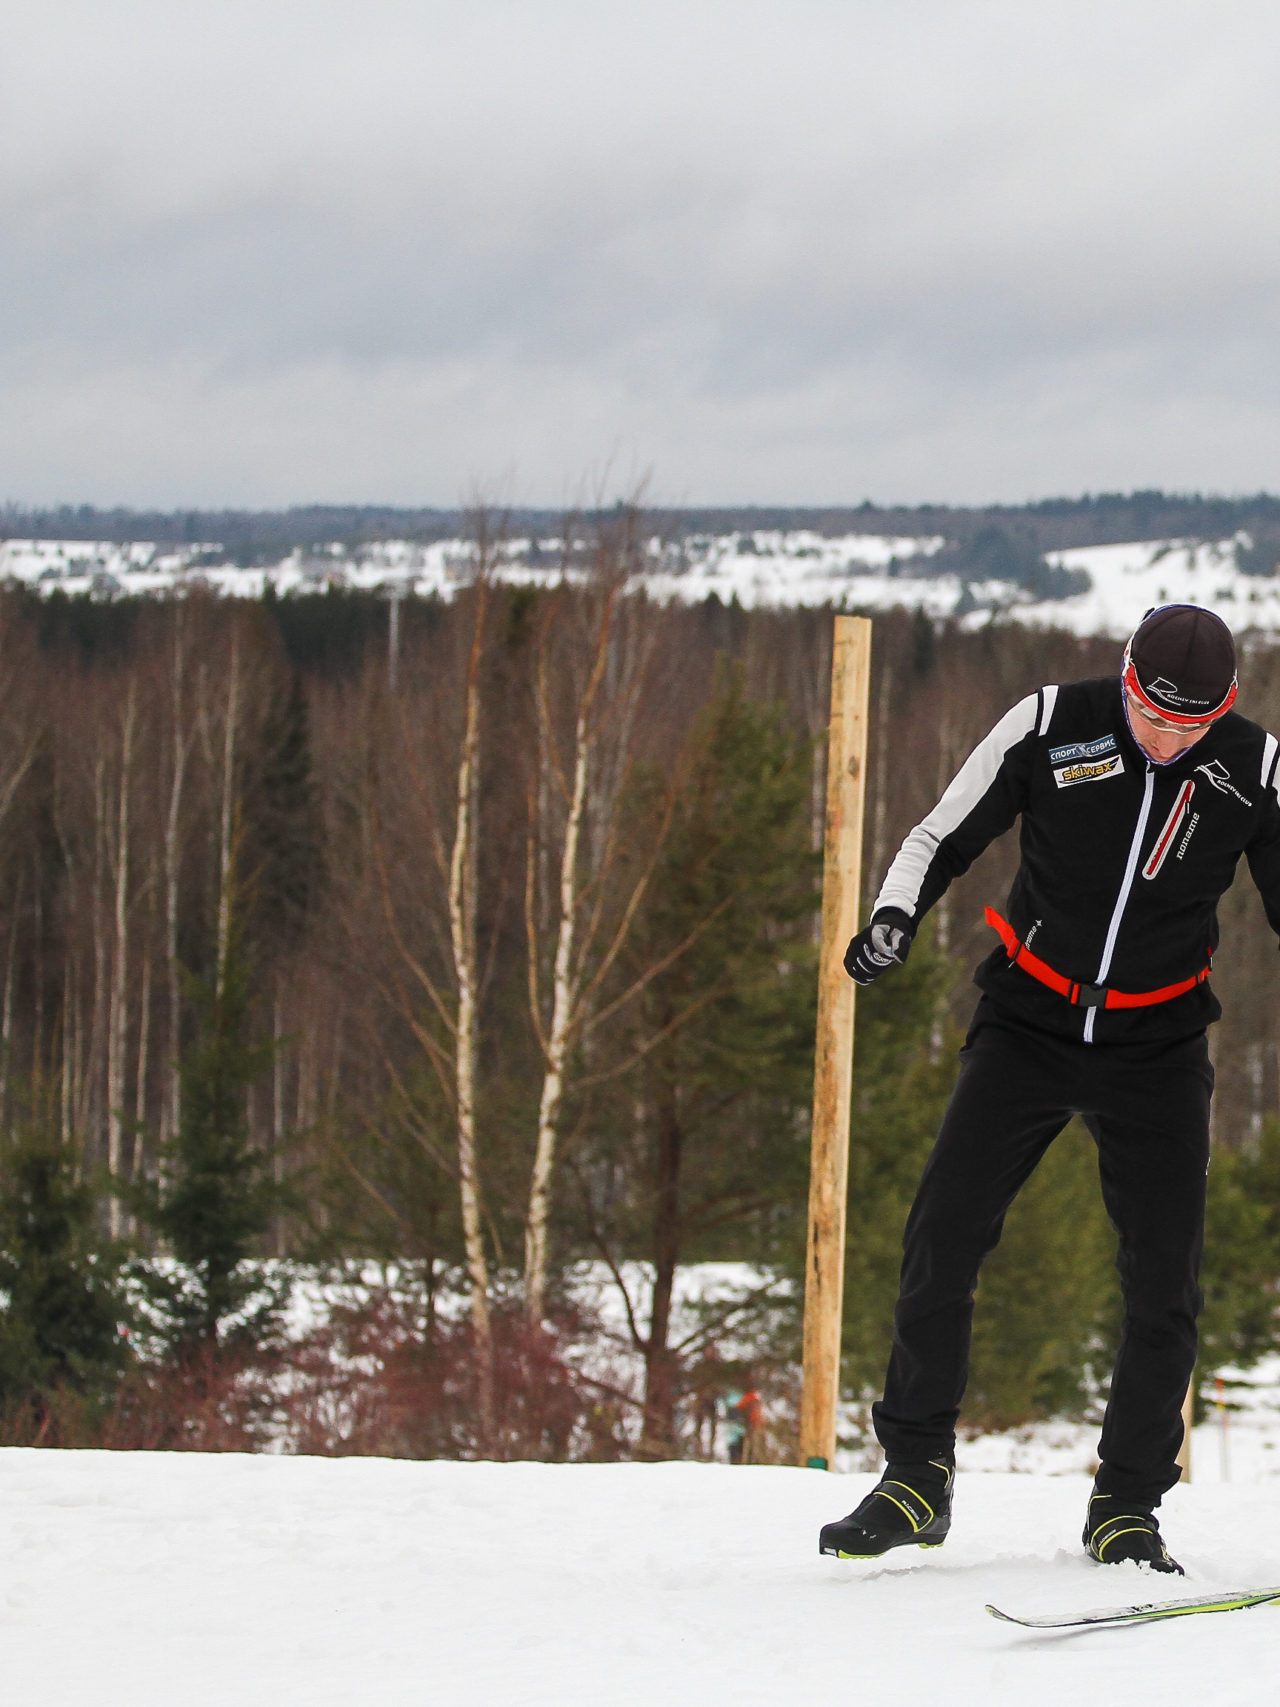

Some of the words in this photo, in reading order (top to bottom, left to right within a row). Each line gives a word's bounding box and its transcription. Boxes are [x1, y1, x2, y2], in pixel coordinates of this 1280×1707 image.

[1050, 747, 1077, 761] СПОРТ
[1086, 738, 1116, 755] СЕРВИС
[1063, 762, 1112, 781] skiwax
[1176, 812, 1200, 860] noname
